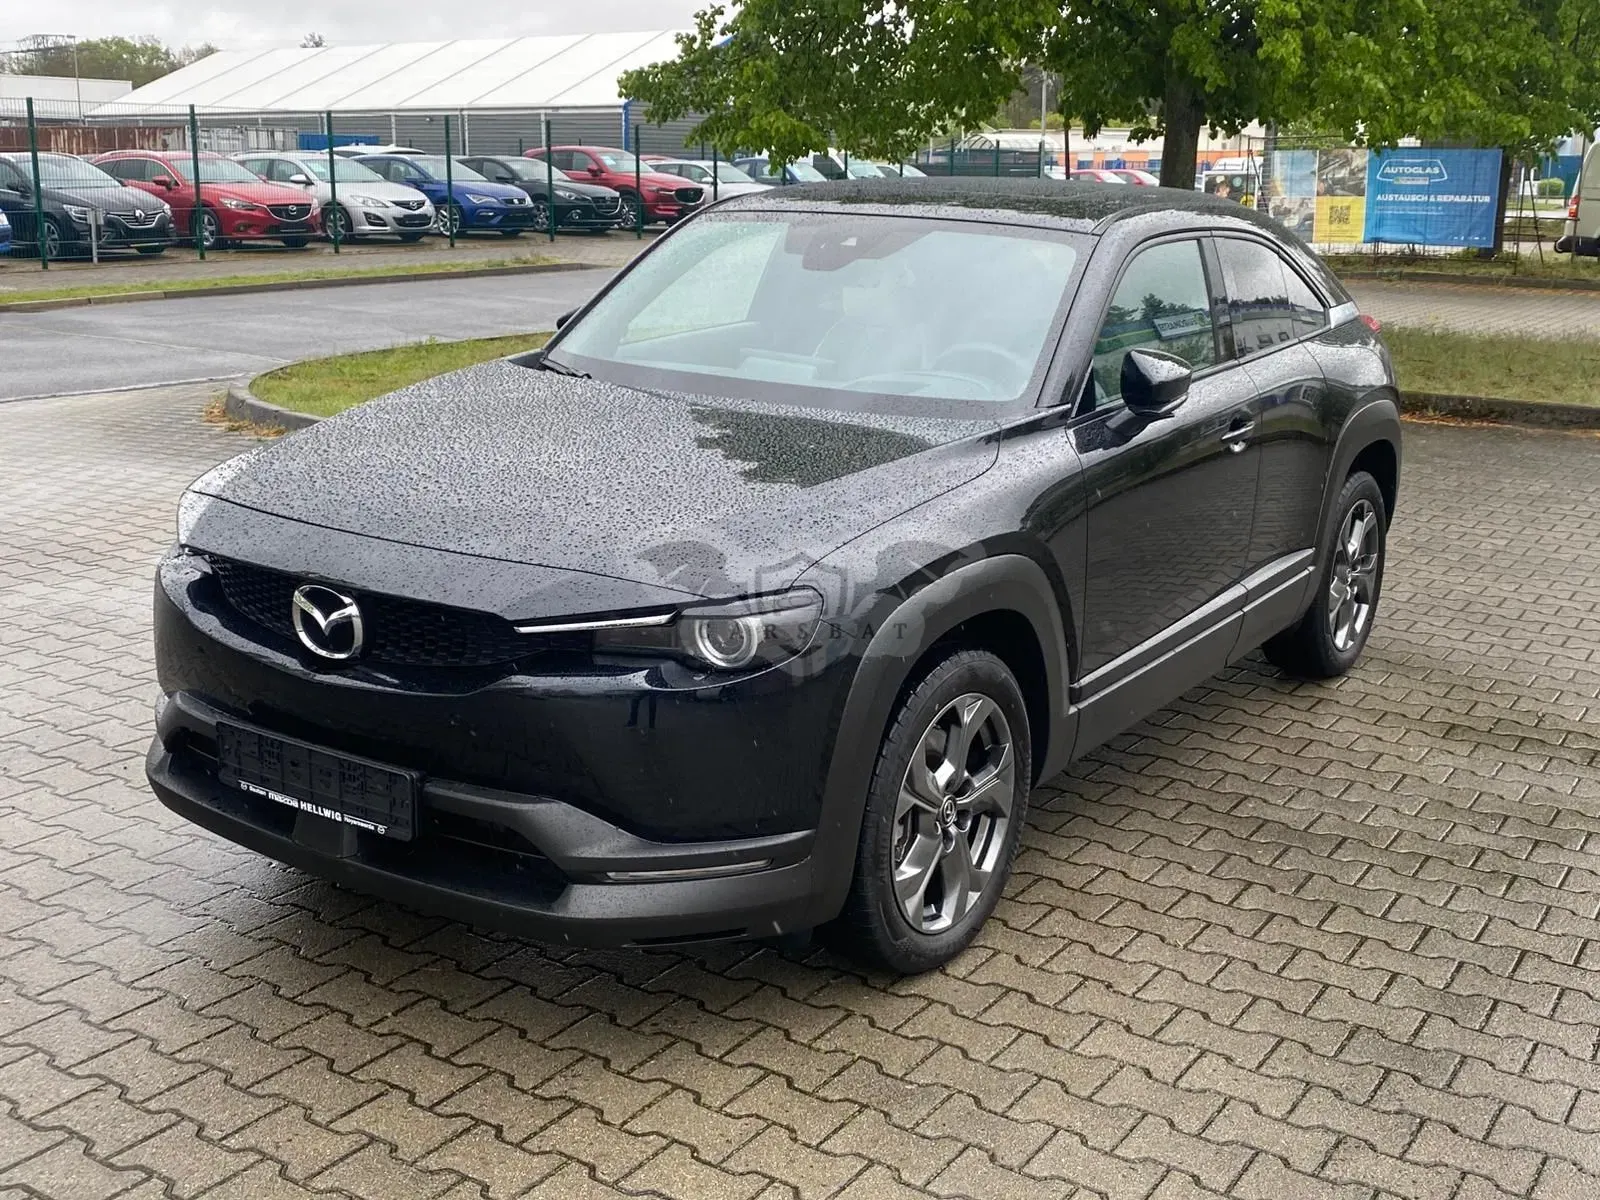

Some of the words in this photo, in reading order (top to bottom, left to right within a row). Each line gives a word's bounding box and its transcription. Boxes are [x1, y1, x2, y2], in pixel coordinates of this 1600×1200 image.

[1383, 166, 1441, 174] AUTOGLAS
[1376, 194, 1428, 202] AUSTAUSCH
[1436, 194, 1491, 203] REPARATUR
[300, 801, 342, 822] HELLWIG
